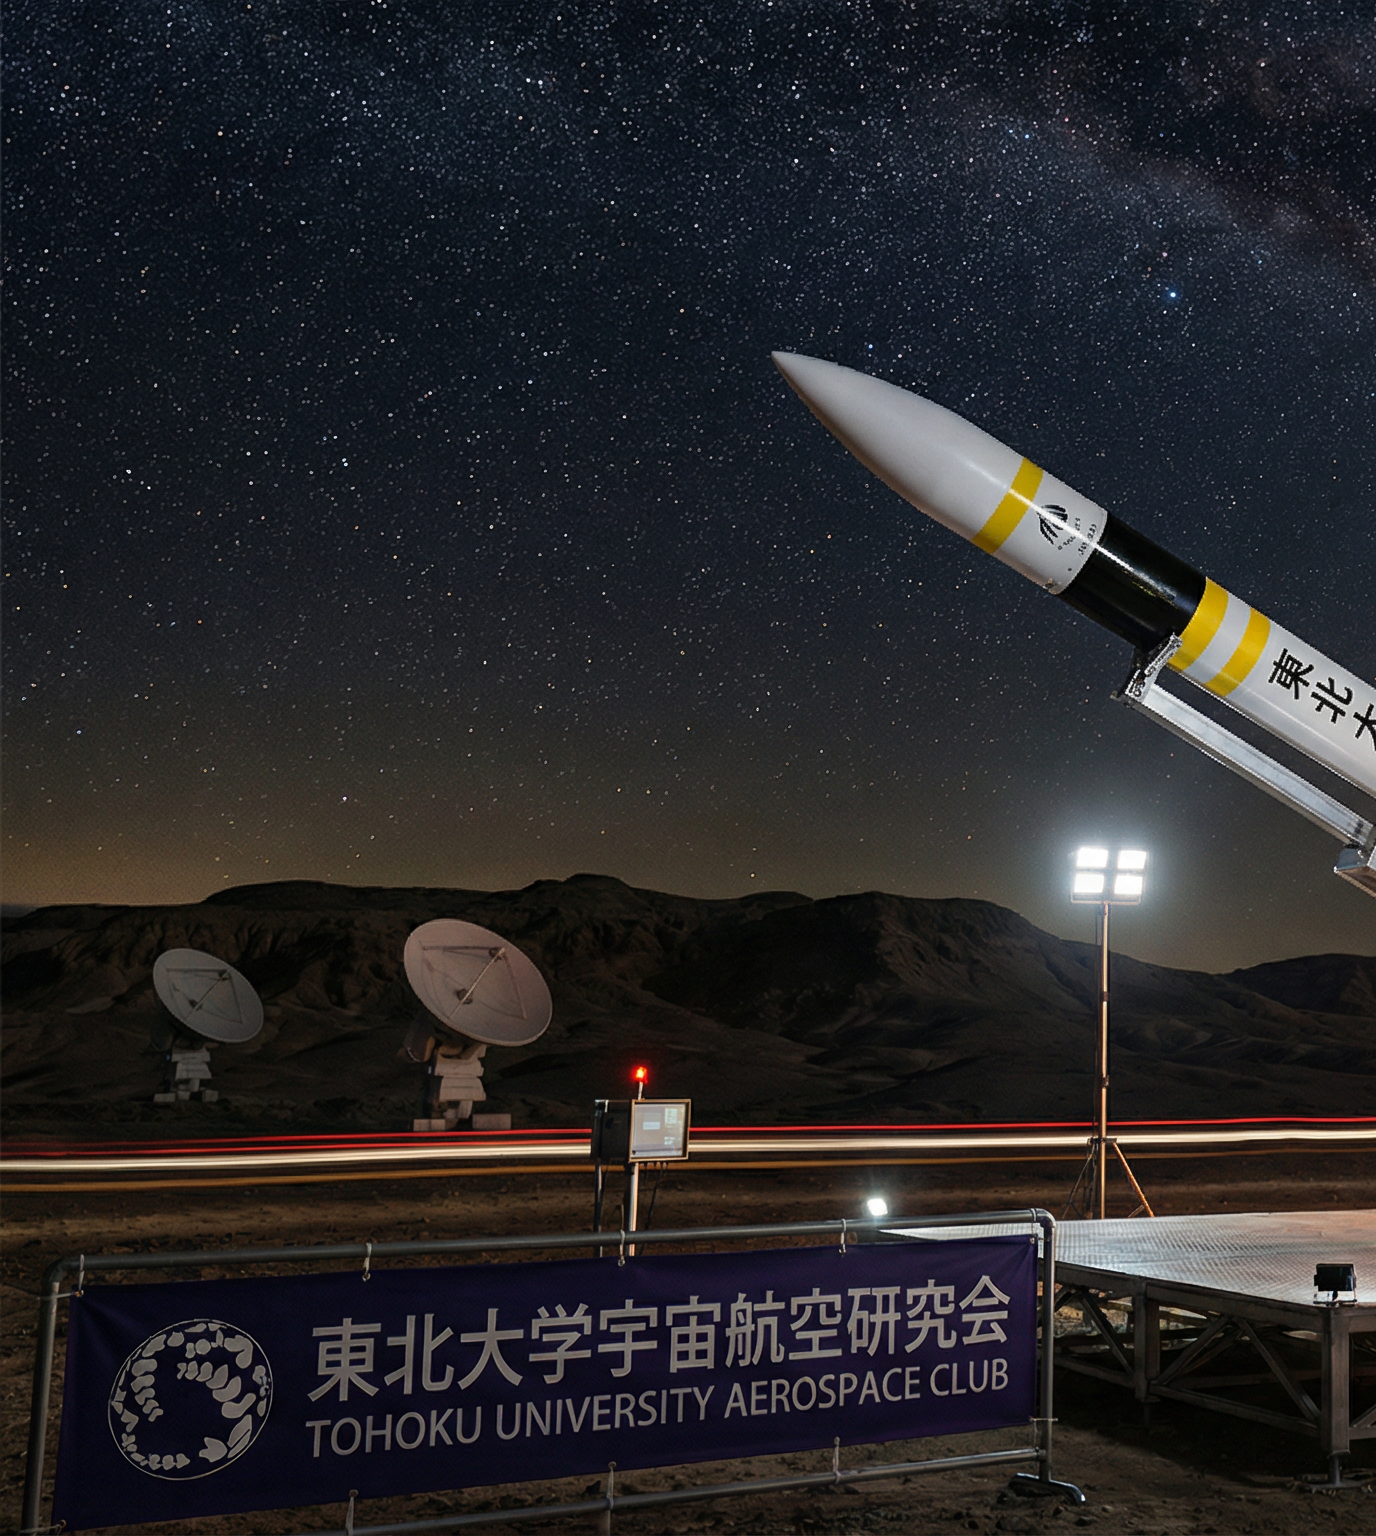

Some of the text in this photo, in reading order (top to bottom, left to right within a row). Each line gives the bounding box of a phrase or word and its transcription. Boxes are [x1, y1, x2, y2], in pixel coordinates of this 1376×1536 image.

[306, 1275, 1011, 1402] 東北大学宇宙航空研究会
[305, 1358, 1010, 1458] TOHOKU UNIVERSITY AEROSPACE CLUB
